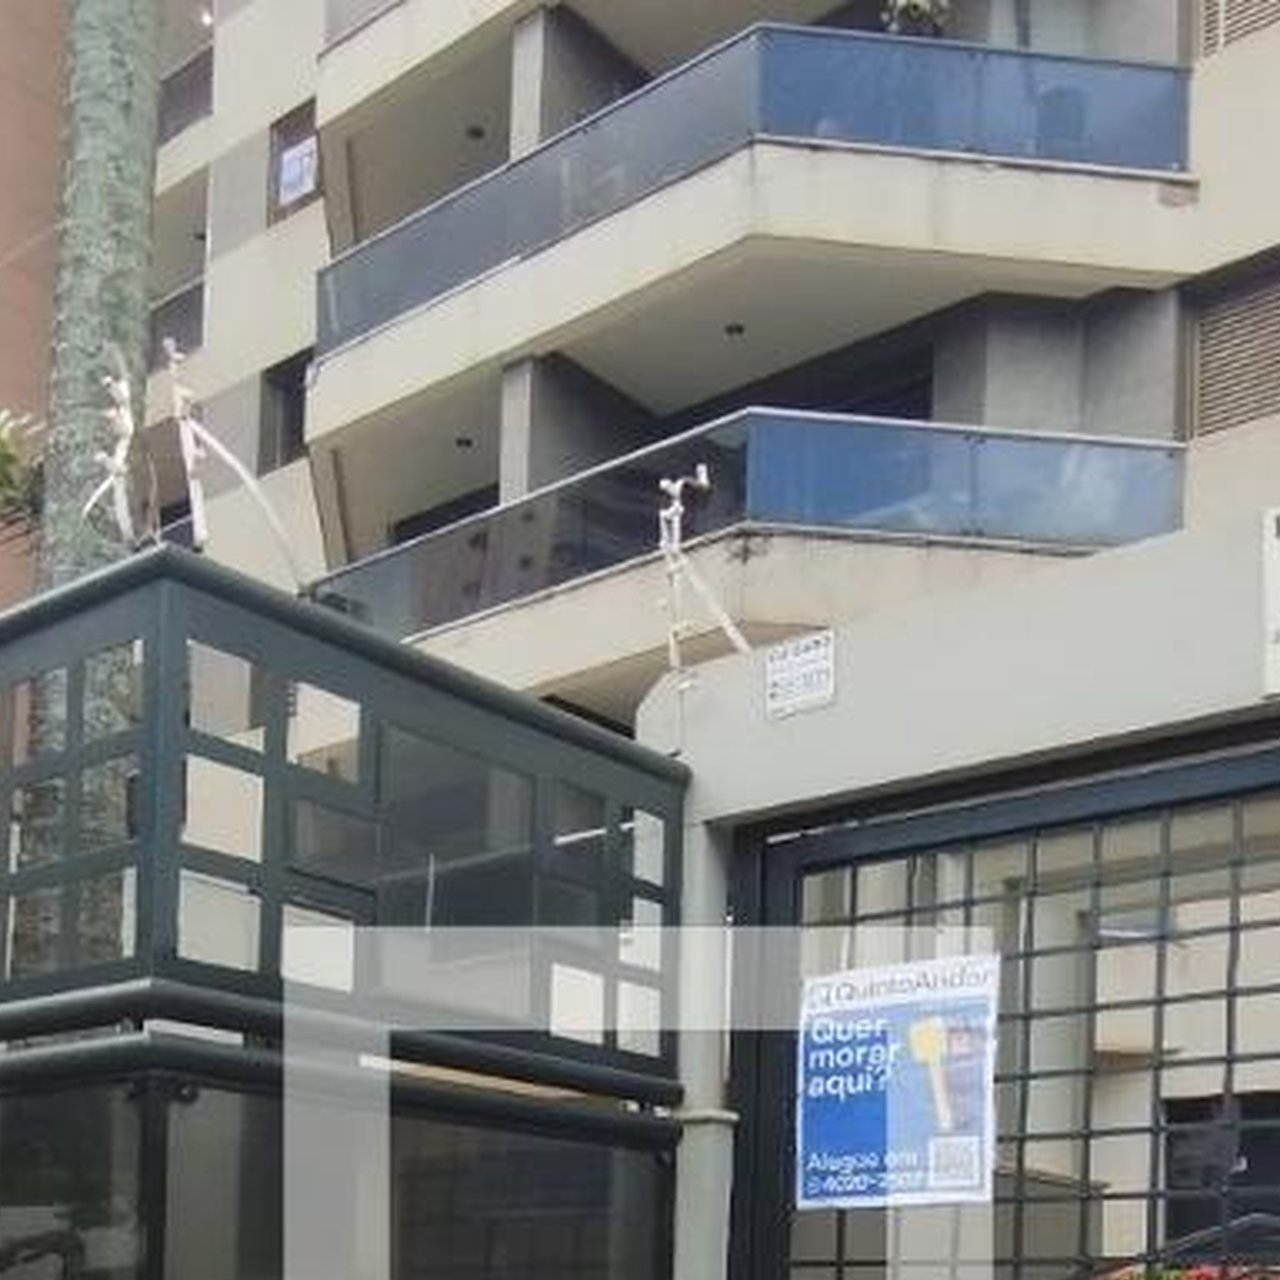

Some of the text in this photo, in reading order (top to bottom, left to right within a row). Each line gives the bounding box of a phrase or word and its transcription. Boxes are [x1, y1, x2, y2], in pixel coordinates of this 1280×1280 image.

[811, 1016, 891, 1044] Quer
[808, 1043, 902, 1070] morar
[807, 1066, 892, 1103] aqui?
